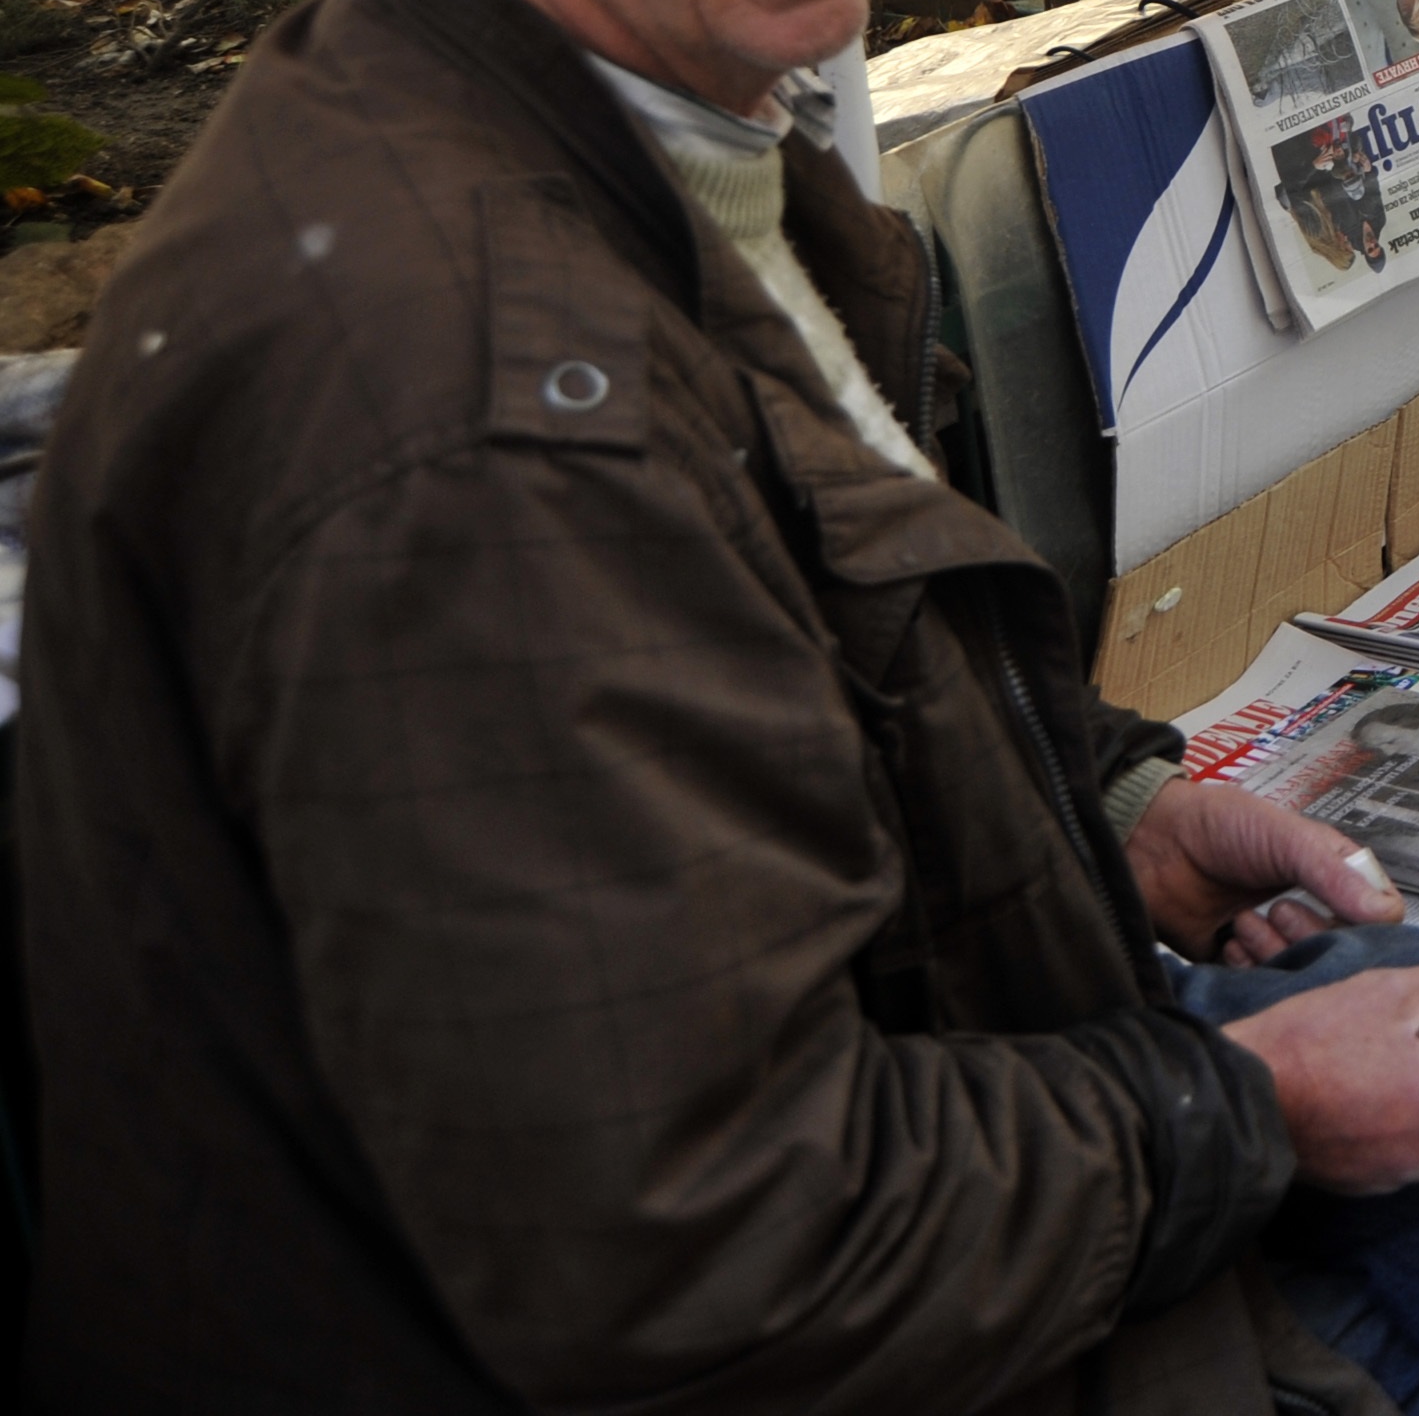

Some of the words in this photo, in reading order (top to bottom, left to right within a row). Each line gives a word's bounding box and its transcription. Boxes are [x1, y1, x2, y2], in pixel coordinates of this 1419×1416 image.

[1375, 57, 1418, 84] HRVATE
[1339, 84, 1371, 101] NOVA
[1275, 95, 1341, 132] STRATEGIJA
